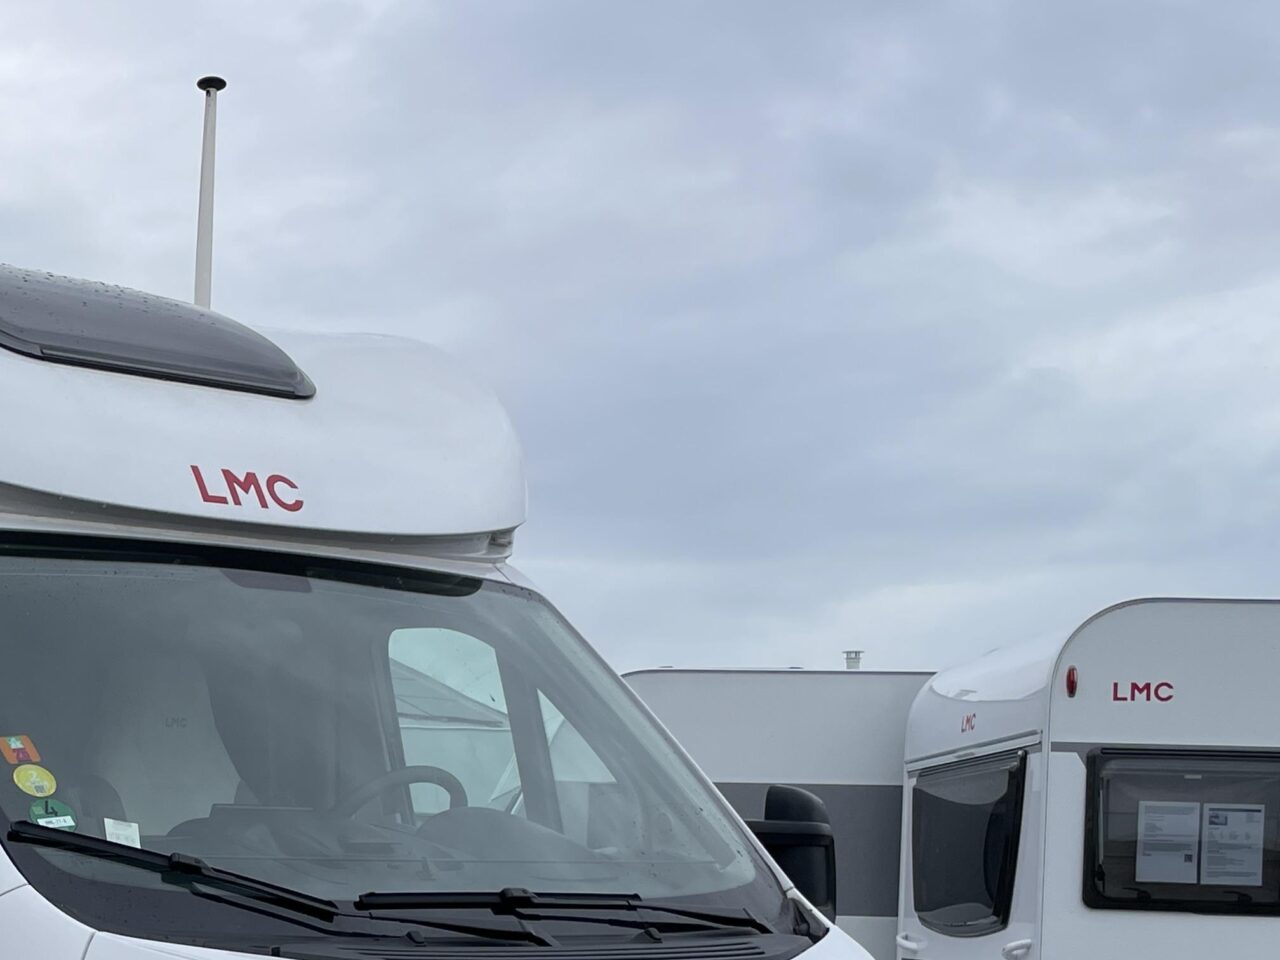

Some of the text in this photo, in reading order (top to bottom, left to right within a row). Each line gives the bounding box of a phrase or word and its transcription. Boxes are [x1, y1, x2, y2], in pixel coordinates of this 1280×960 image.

[190, 465, 304, 512] LMC
[1113, 682, 1174, 701] LMC
[961, 713, 976, 733] LMC
[45, 800, 59, 816] 4
